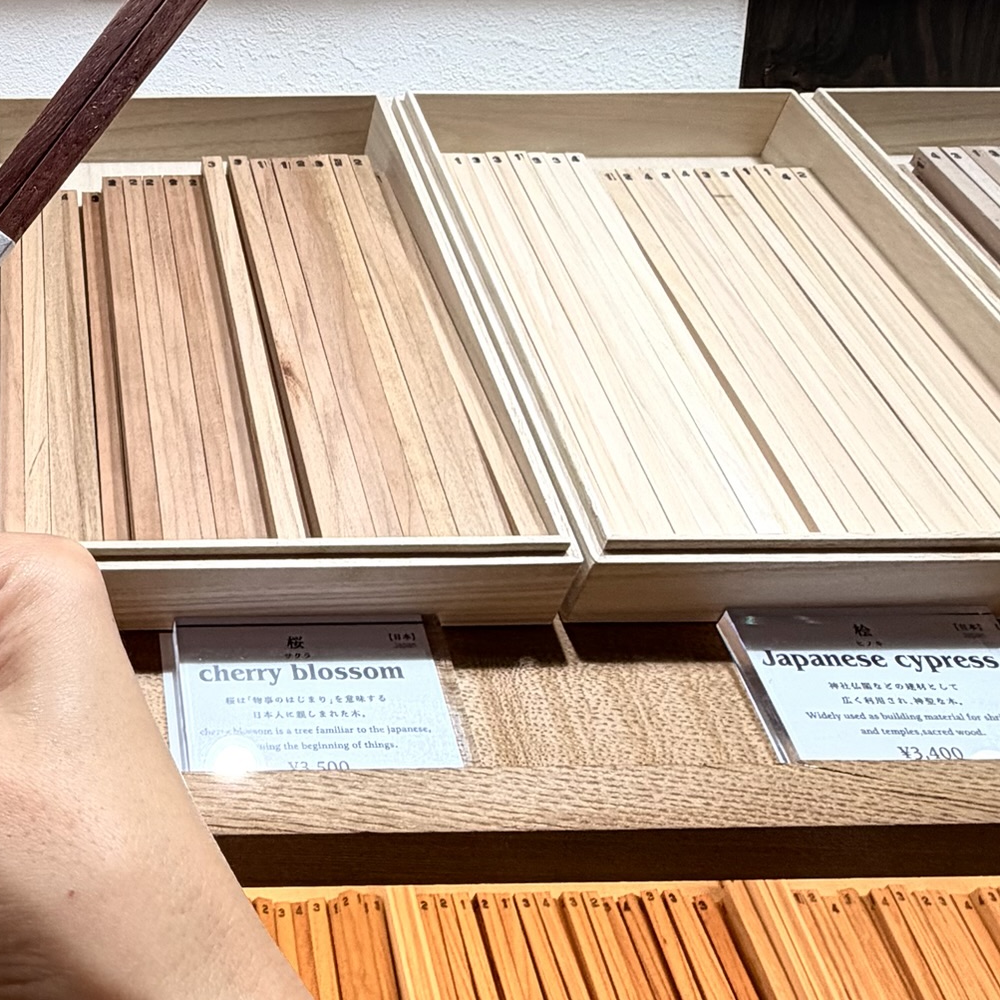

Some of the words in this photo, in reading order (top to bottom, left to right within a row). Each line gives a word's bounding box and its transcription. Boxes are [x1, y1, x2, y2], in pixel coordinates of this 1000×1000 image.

[287, 636, 304, 649] 桜
[762, 650, 888, 671] Japanese
[895, 655, 999, 672] cypress
[199, 664, 282, 686] cherry
[291, 664, 404, 680] blossom
[805, 712, 840, 721] Widely
[844, 711, 866, 720] used
[868, 713, 879, 721] as
[880, 712, 923, 722] building
[924, 712, 965, 721] material
[966, 712, 981, 721] for
[276, 727, 283, 735] is
[294, 727, 312, 735] tree
[316, 725, 354, 735] familiar
[357, 726, 366, 734] to
[369, 725, 384, 734] the
[387, 725, 431, 735] japanese,
[860, 726, 880, 735] and
[881, 728, 954, 737] temples,sacred
[956, 727, 986, 737] wood.
[284, 741, 298, 751] the
[302, 742, 350, 751] beginning
[352, 740, 362, 749] of
[364, 741, 398, 750] things.
[897, 747, 963, 760] ¥3,400
[288, 761, 349, 770] ¥3500
